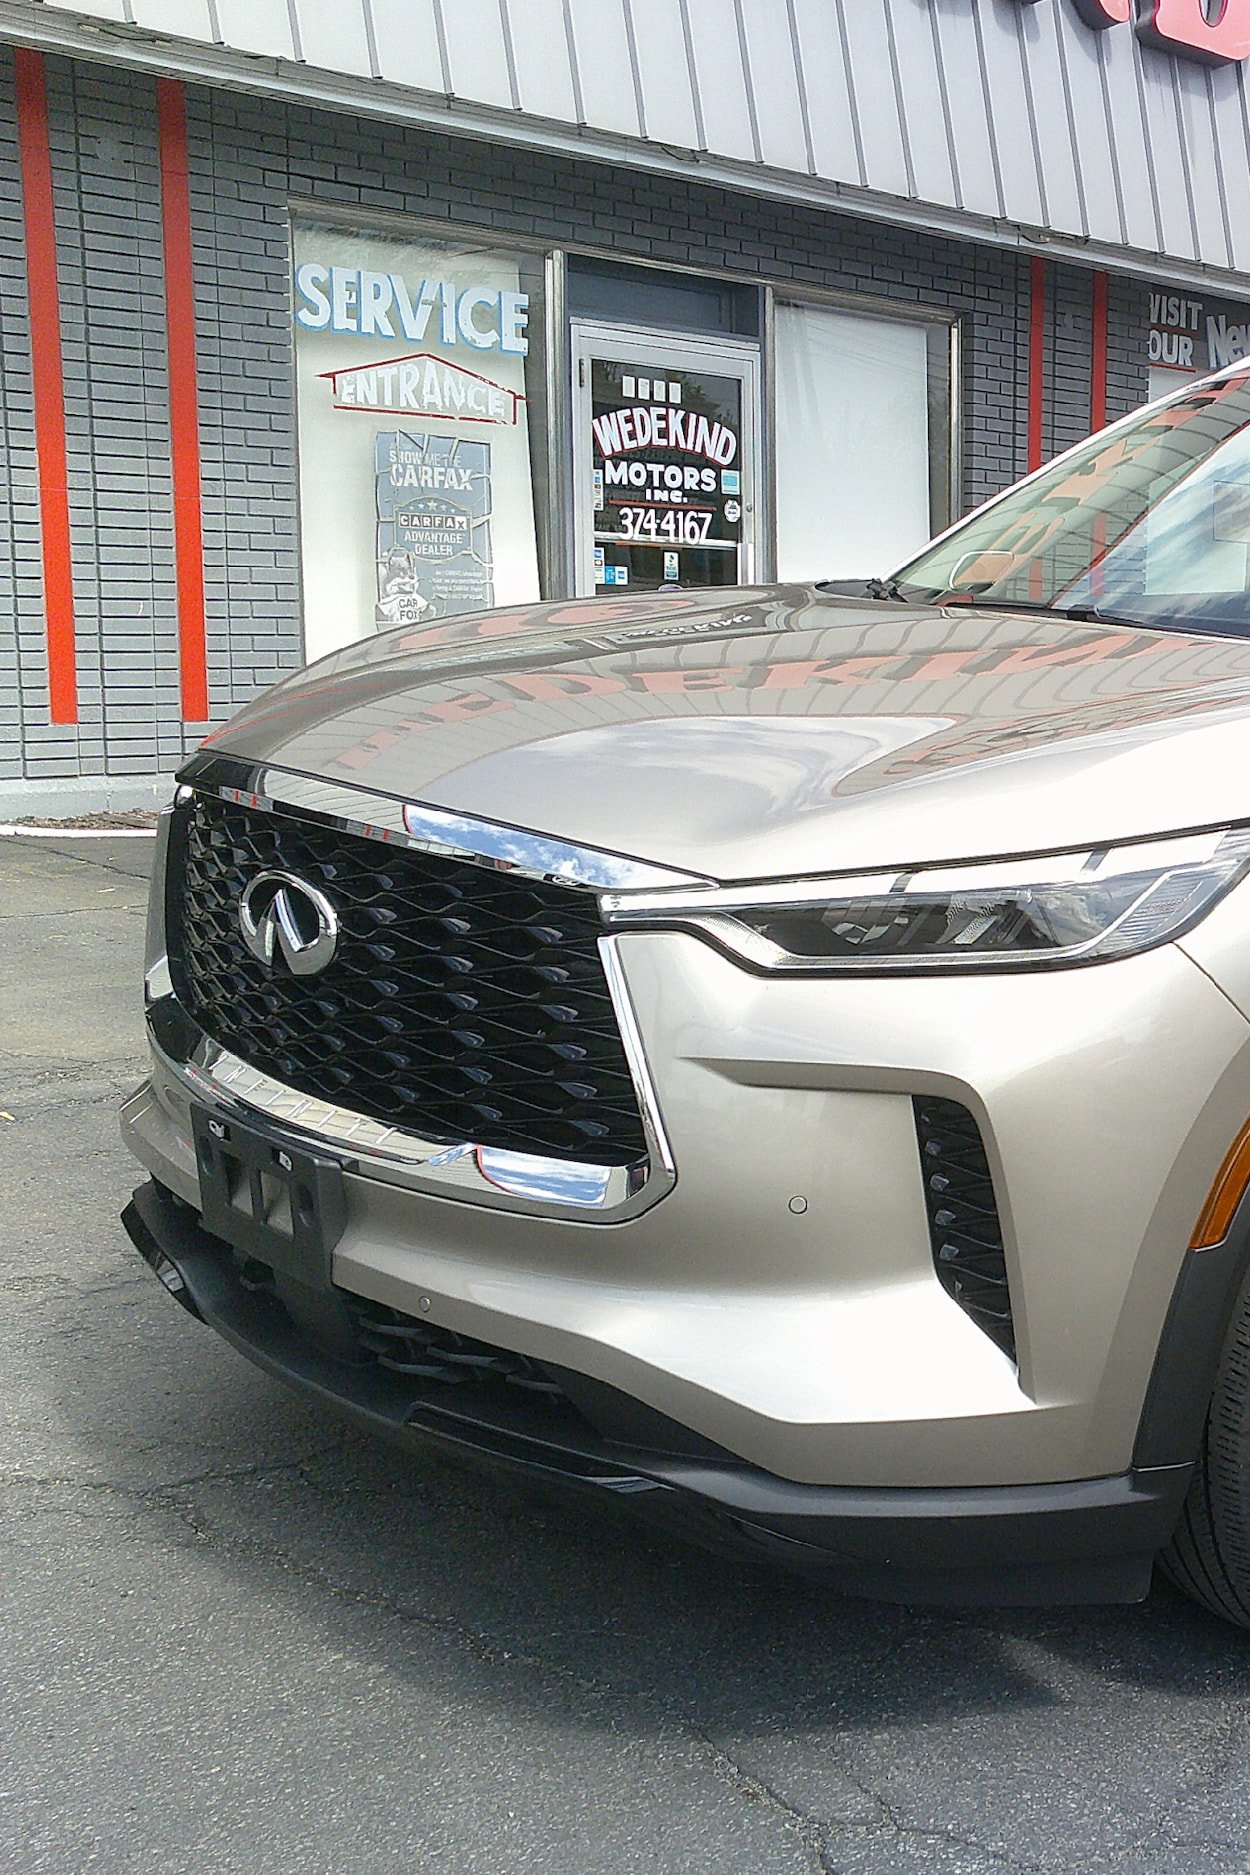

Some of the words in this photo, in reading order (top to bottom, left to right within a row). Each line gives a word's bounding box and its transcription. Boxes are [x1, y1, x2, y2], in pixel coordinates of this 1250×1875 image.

[296, 263, 529, 356] SERVICE
[1149, 293, 1203, 332] VISIT
[1149, 329, 1194, 367] OUR
[340, 360, 506, 417] ENTRANCE
[591, 406, 738, 467] WEDEKIND
[390, 463, 473, 491] CARFAX
[604, 459, 717, 493] MOTORS
[645, 488, 688, 503] INC.
[400, 514, 467, 530] CARFAX
[404, 530, 463, 544] ADVANTAGE
[618, 506, 713, 546] 374-4167
[415, 543, 453, 556] DEALER
[399, 598, 418, 609] CAR
[400, 610, 418, 621] FOX
